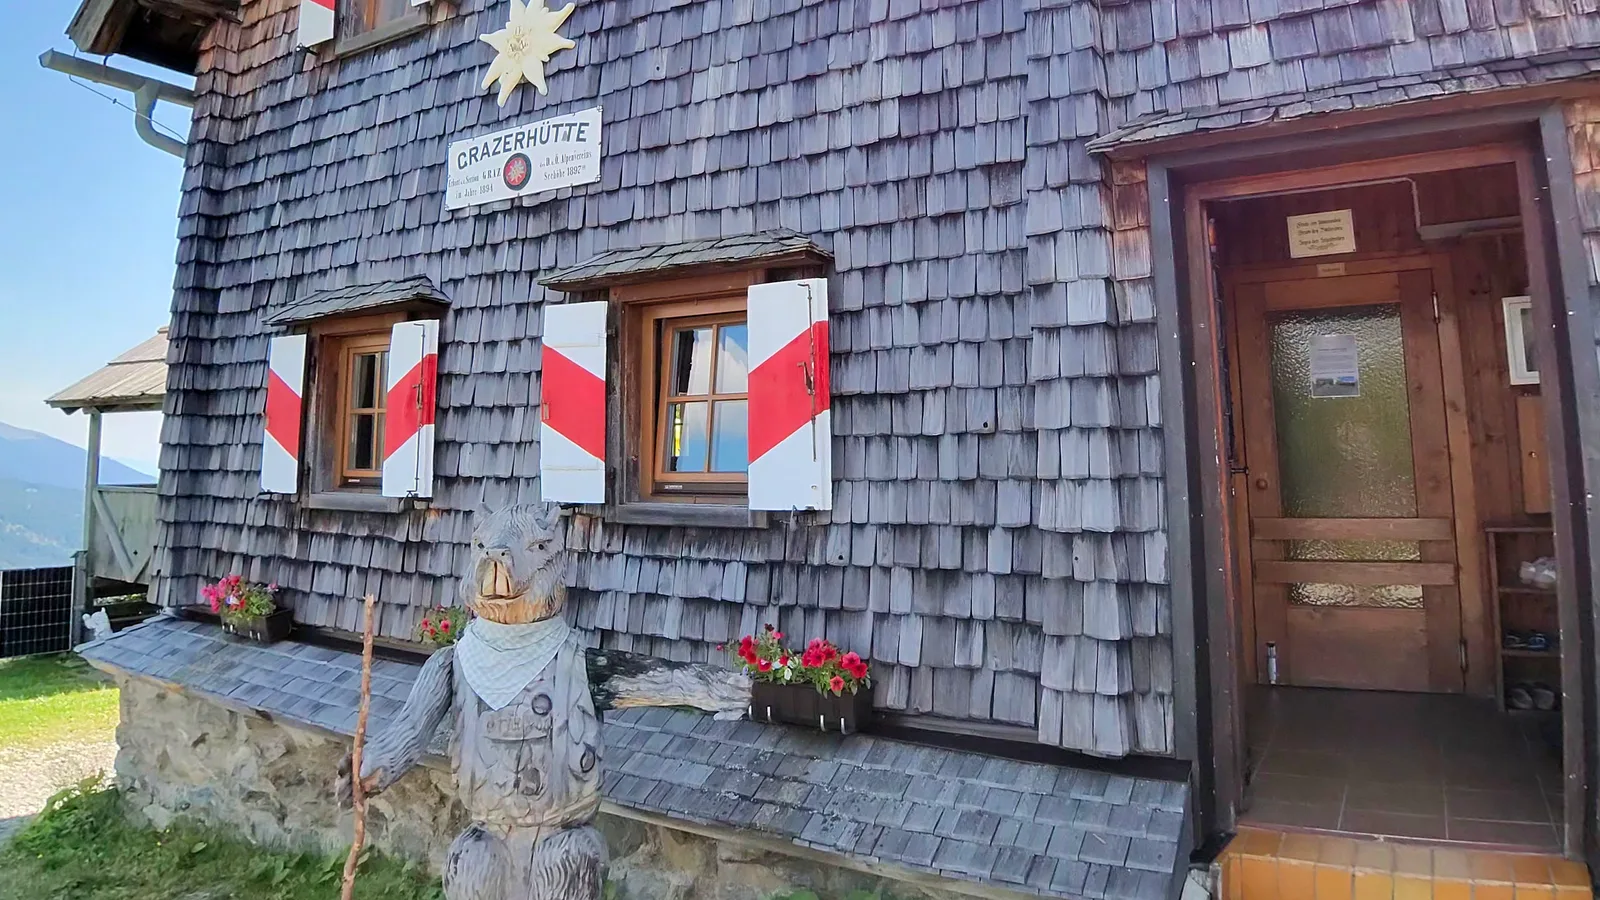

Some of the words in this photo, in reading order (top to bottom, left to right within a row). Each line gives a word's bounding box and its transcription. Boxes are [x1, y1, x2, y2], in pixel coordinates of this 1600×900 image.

[457, 121, 590, 170] GRAZERHÜTTE
[482, 168, 502, 180] GRAZ
[479, 183, 493, 195] 1894
